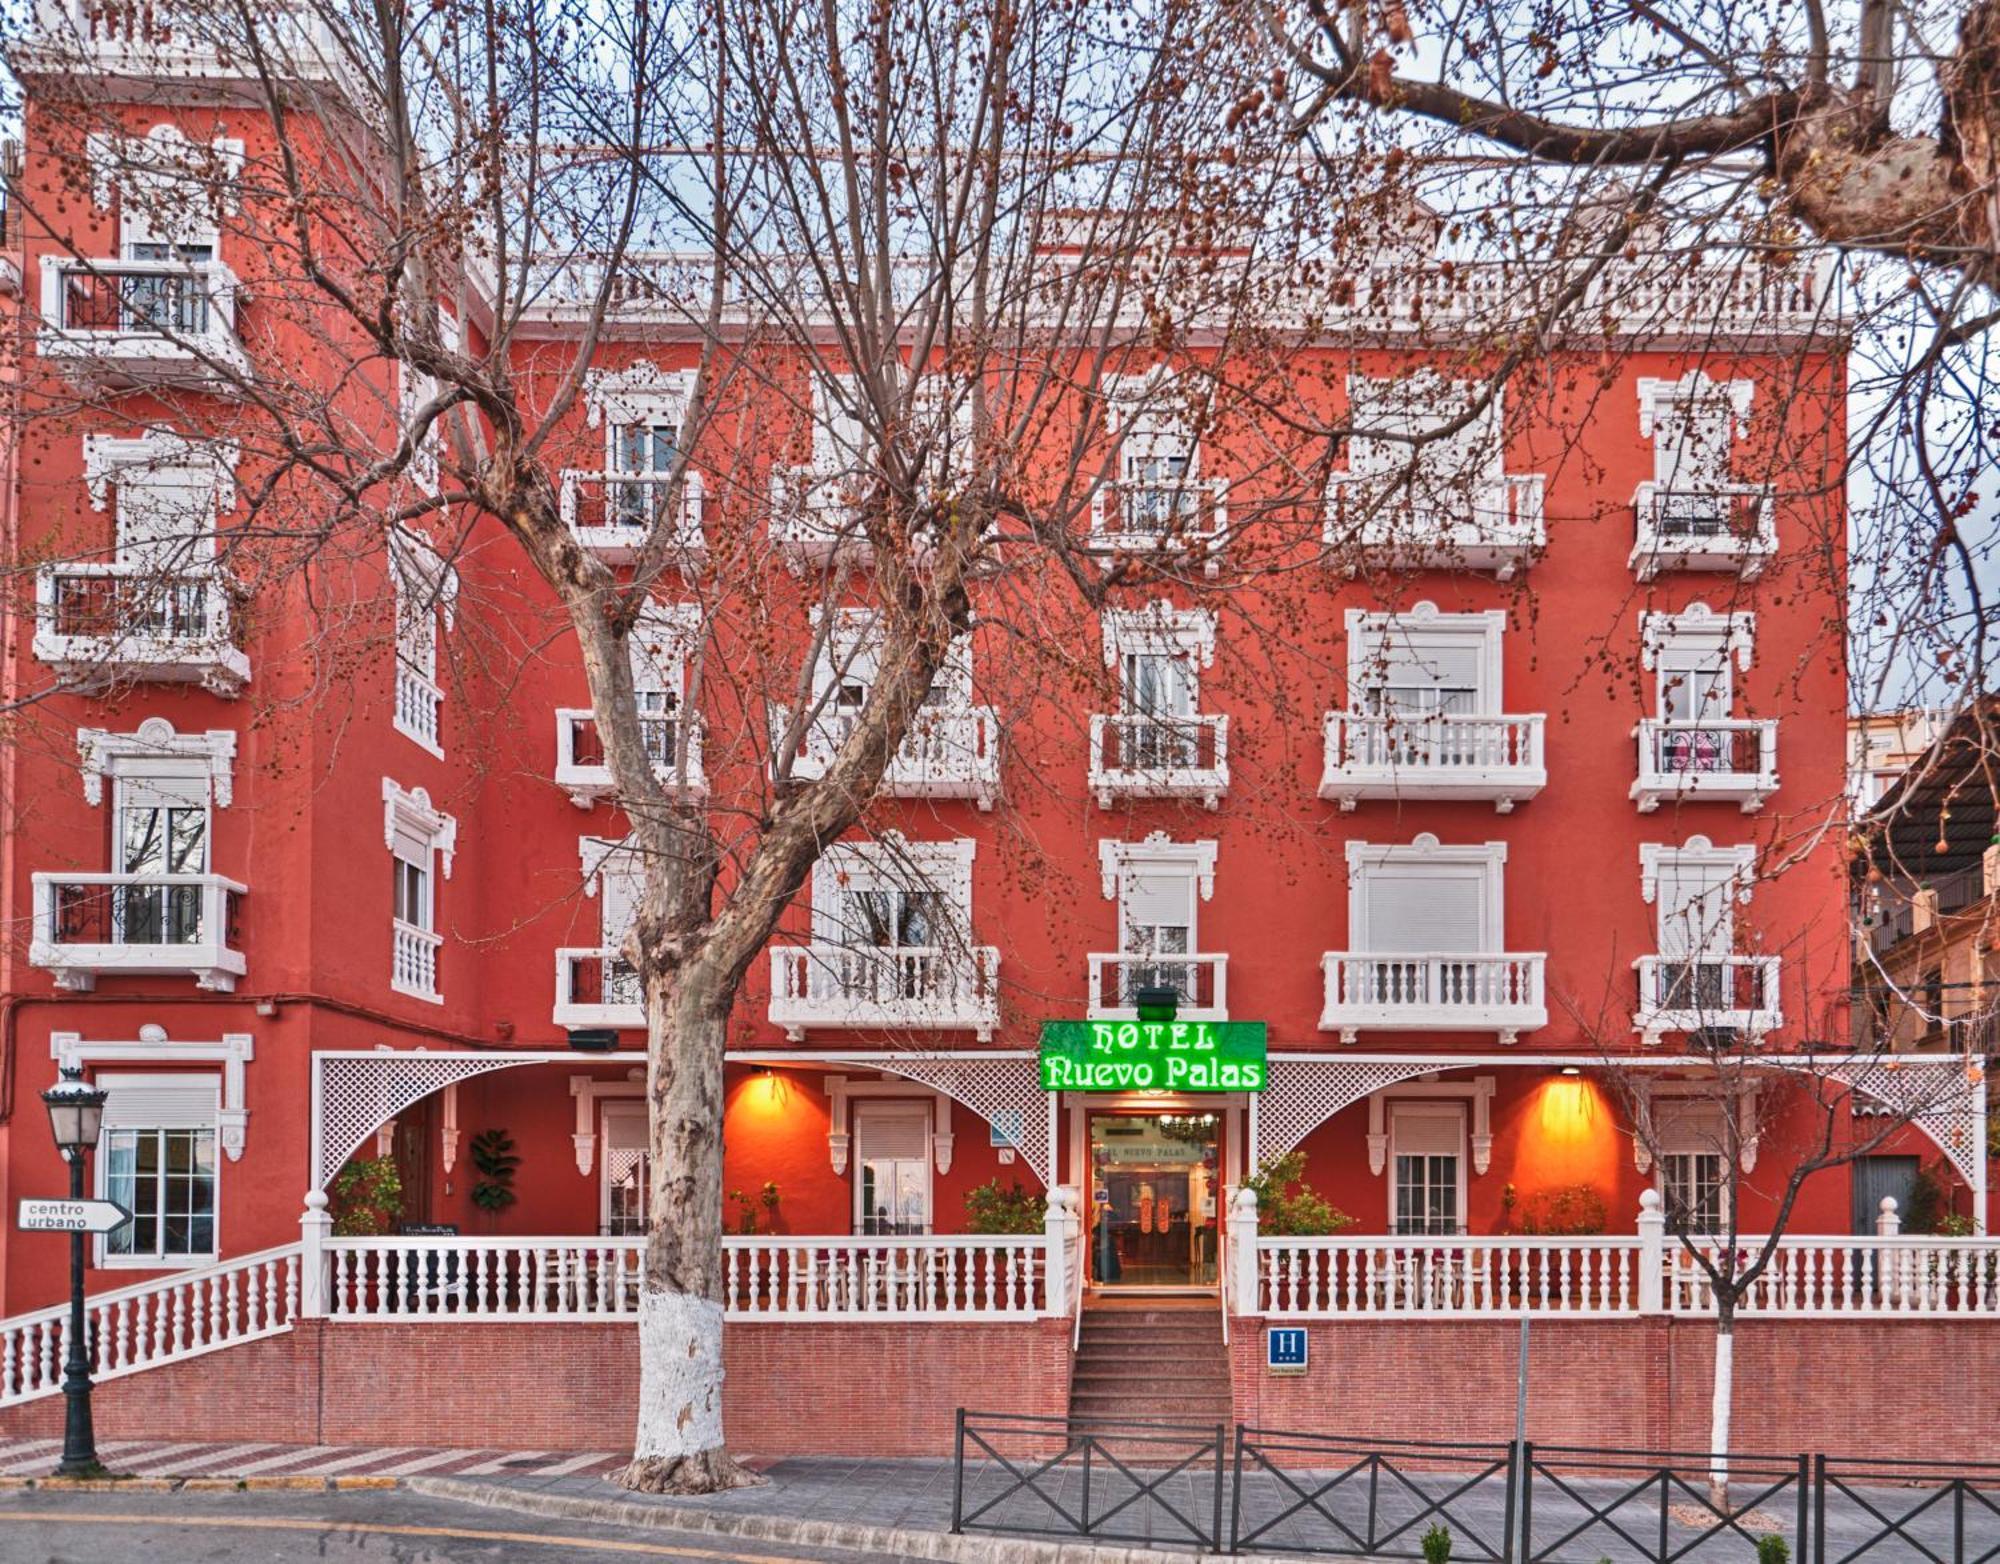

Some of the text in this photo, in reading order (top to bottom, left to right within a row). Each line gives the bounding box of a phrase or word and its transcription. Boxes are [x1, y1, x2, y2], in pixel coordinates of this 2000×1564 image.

[1092, 1023, 1215, 1054] HOTEL
[1045, 1055, 1261, 1088] Nuevo Palas
[29, 1203, 85, 1216] centro
[27, 1216, 87, 1229] urbano
[1278, 1332, 1297, 1353] H
